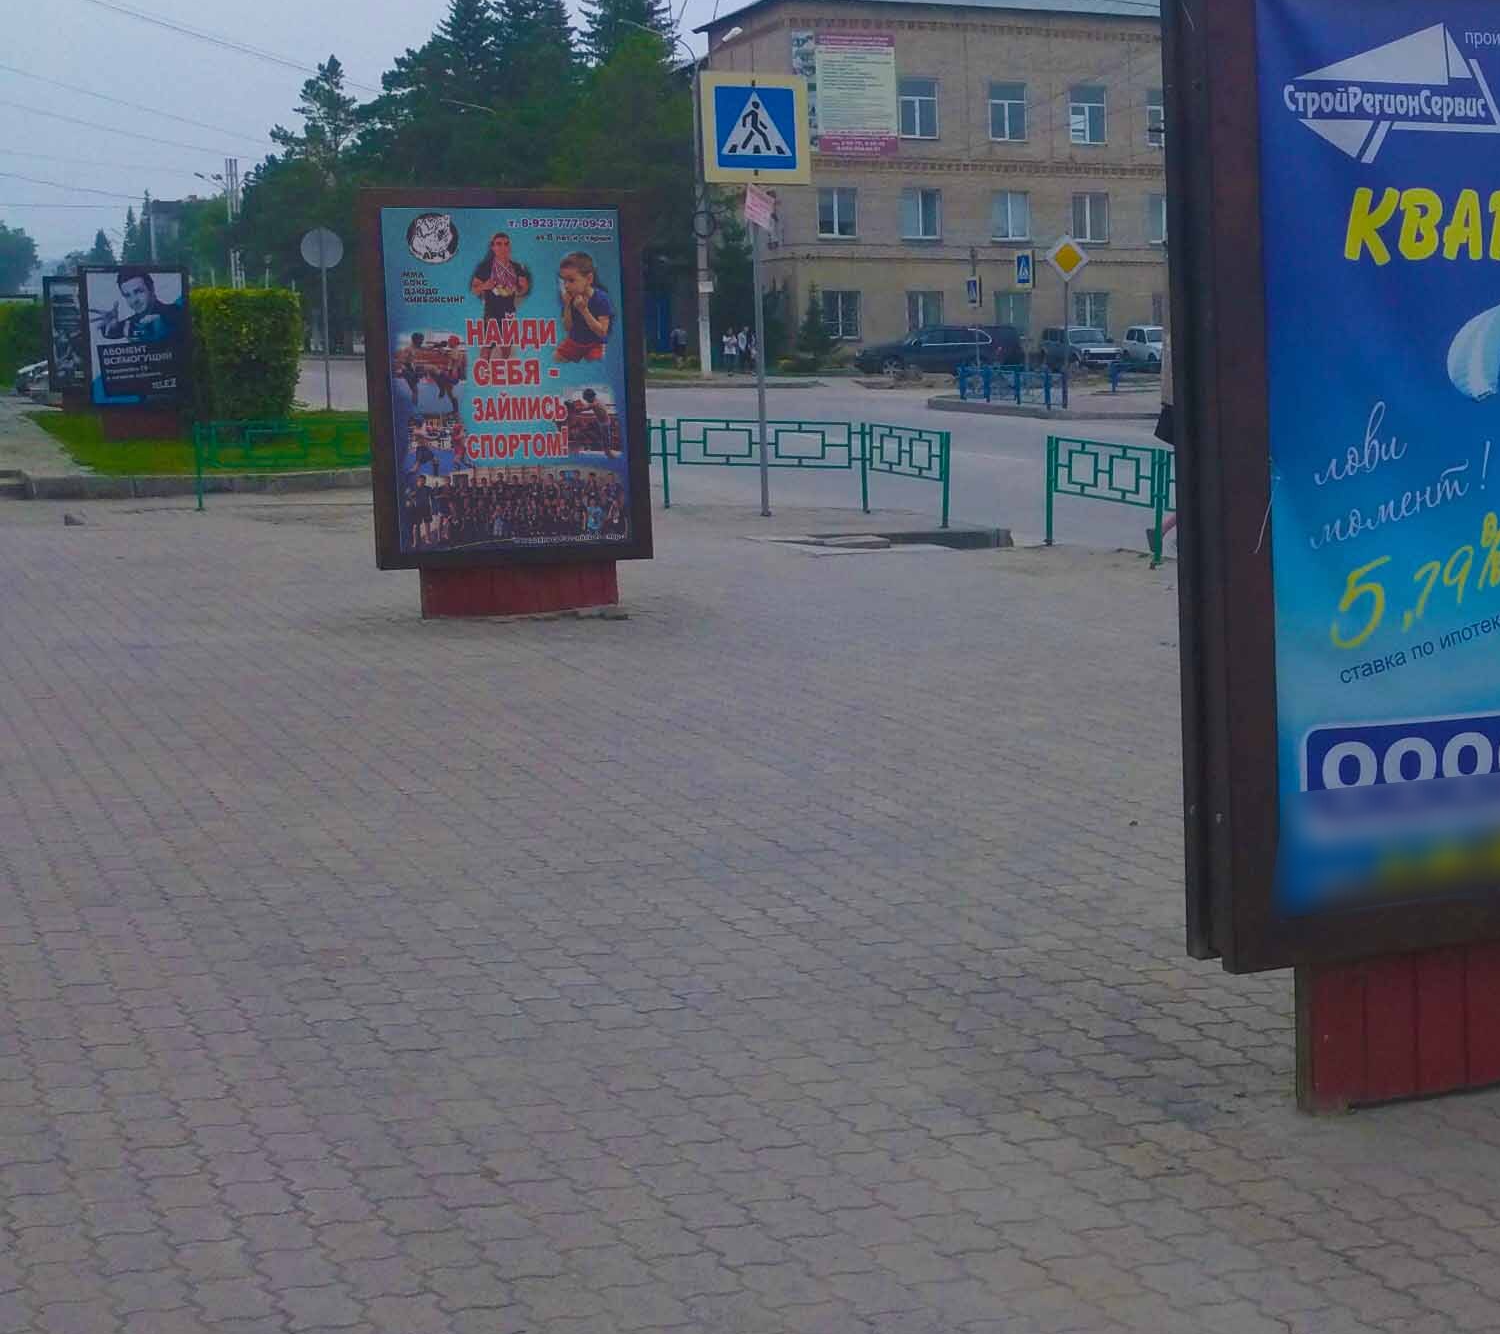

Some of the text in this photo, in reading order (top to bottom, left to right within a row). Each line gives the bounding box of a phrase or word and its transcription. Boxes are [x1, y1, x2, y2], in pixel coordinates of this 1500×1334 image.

[1283, 84, 1487, 119] СтройРегионСервис
[465, 314, 557, 351] НАЙДИ
[472, 358, 541, 386] СЕБЯ
[472, 392, 568, 422] ЗАЙМИСЬ
[466, 426, 568, 460] СПОРТОМ!
[1313, 401, 1408, 486] лови
[1339, 649, 1408, 685] ставка
[1411, 640, 1435, 660] по
